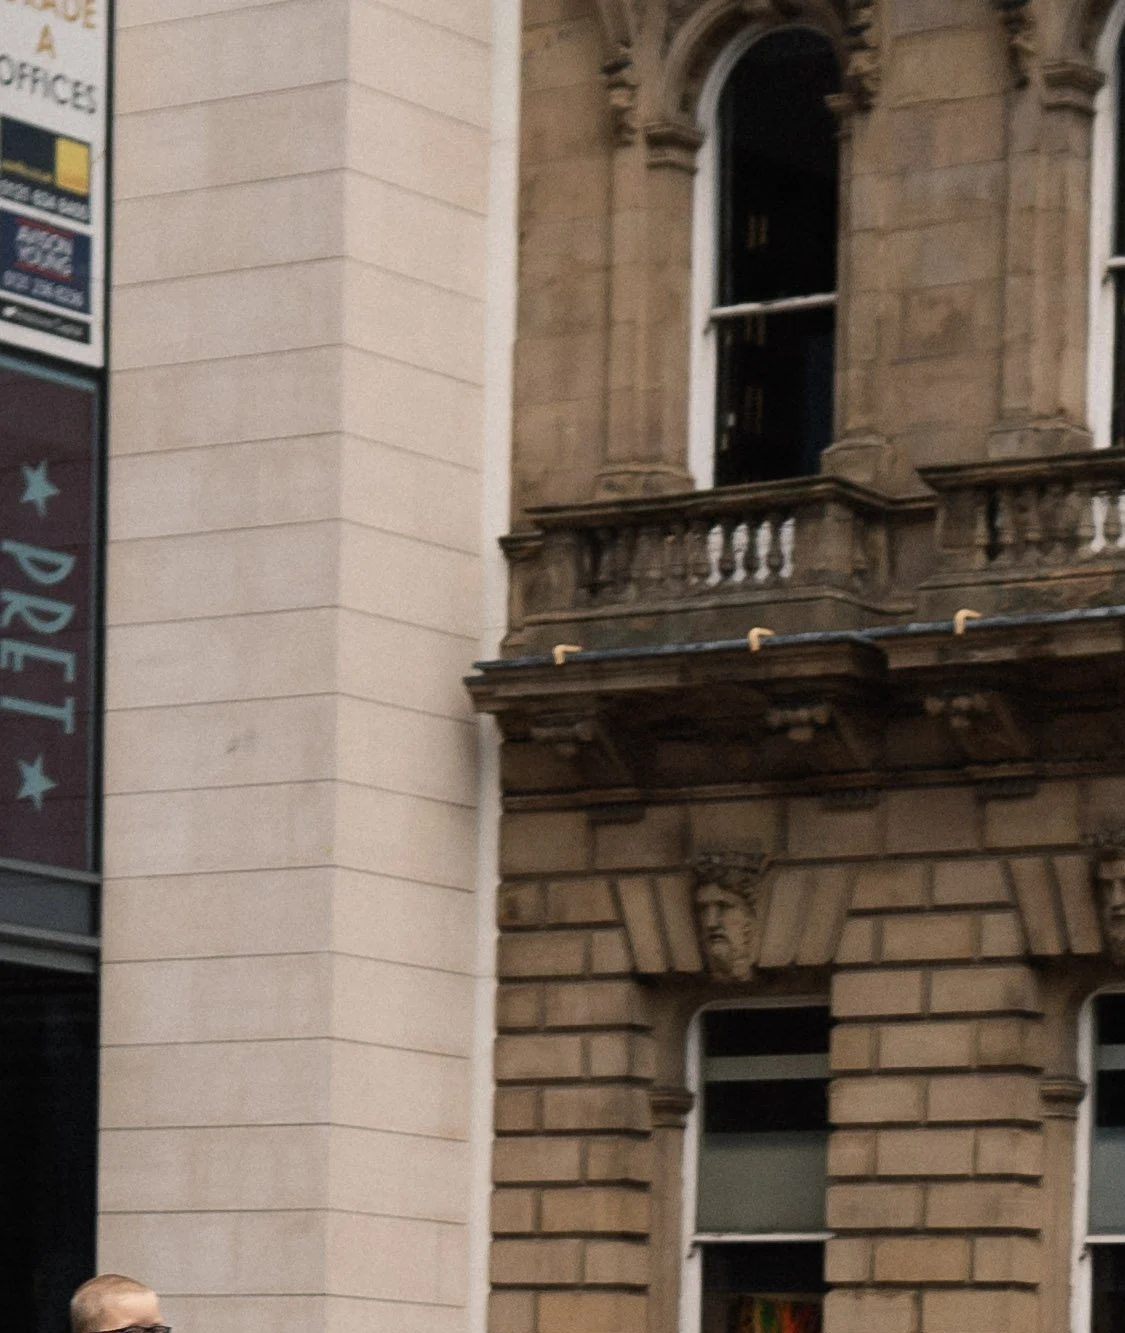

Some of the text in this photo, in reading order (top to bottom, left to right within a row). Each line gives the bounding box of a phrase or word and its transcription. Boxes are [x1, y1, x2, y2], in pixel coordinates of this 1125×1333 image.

[34, 24, 56, 59] A
[0, 54, 97, 114] OFFICES
[0, 538, 76, 736] PRET
